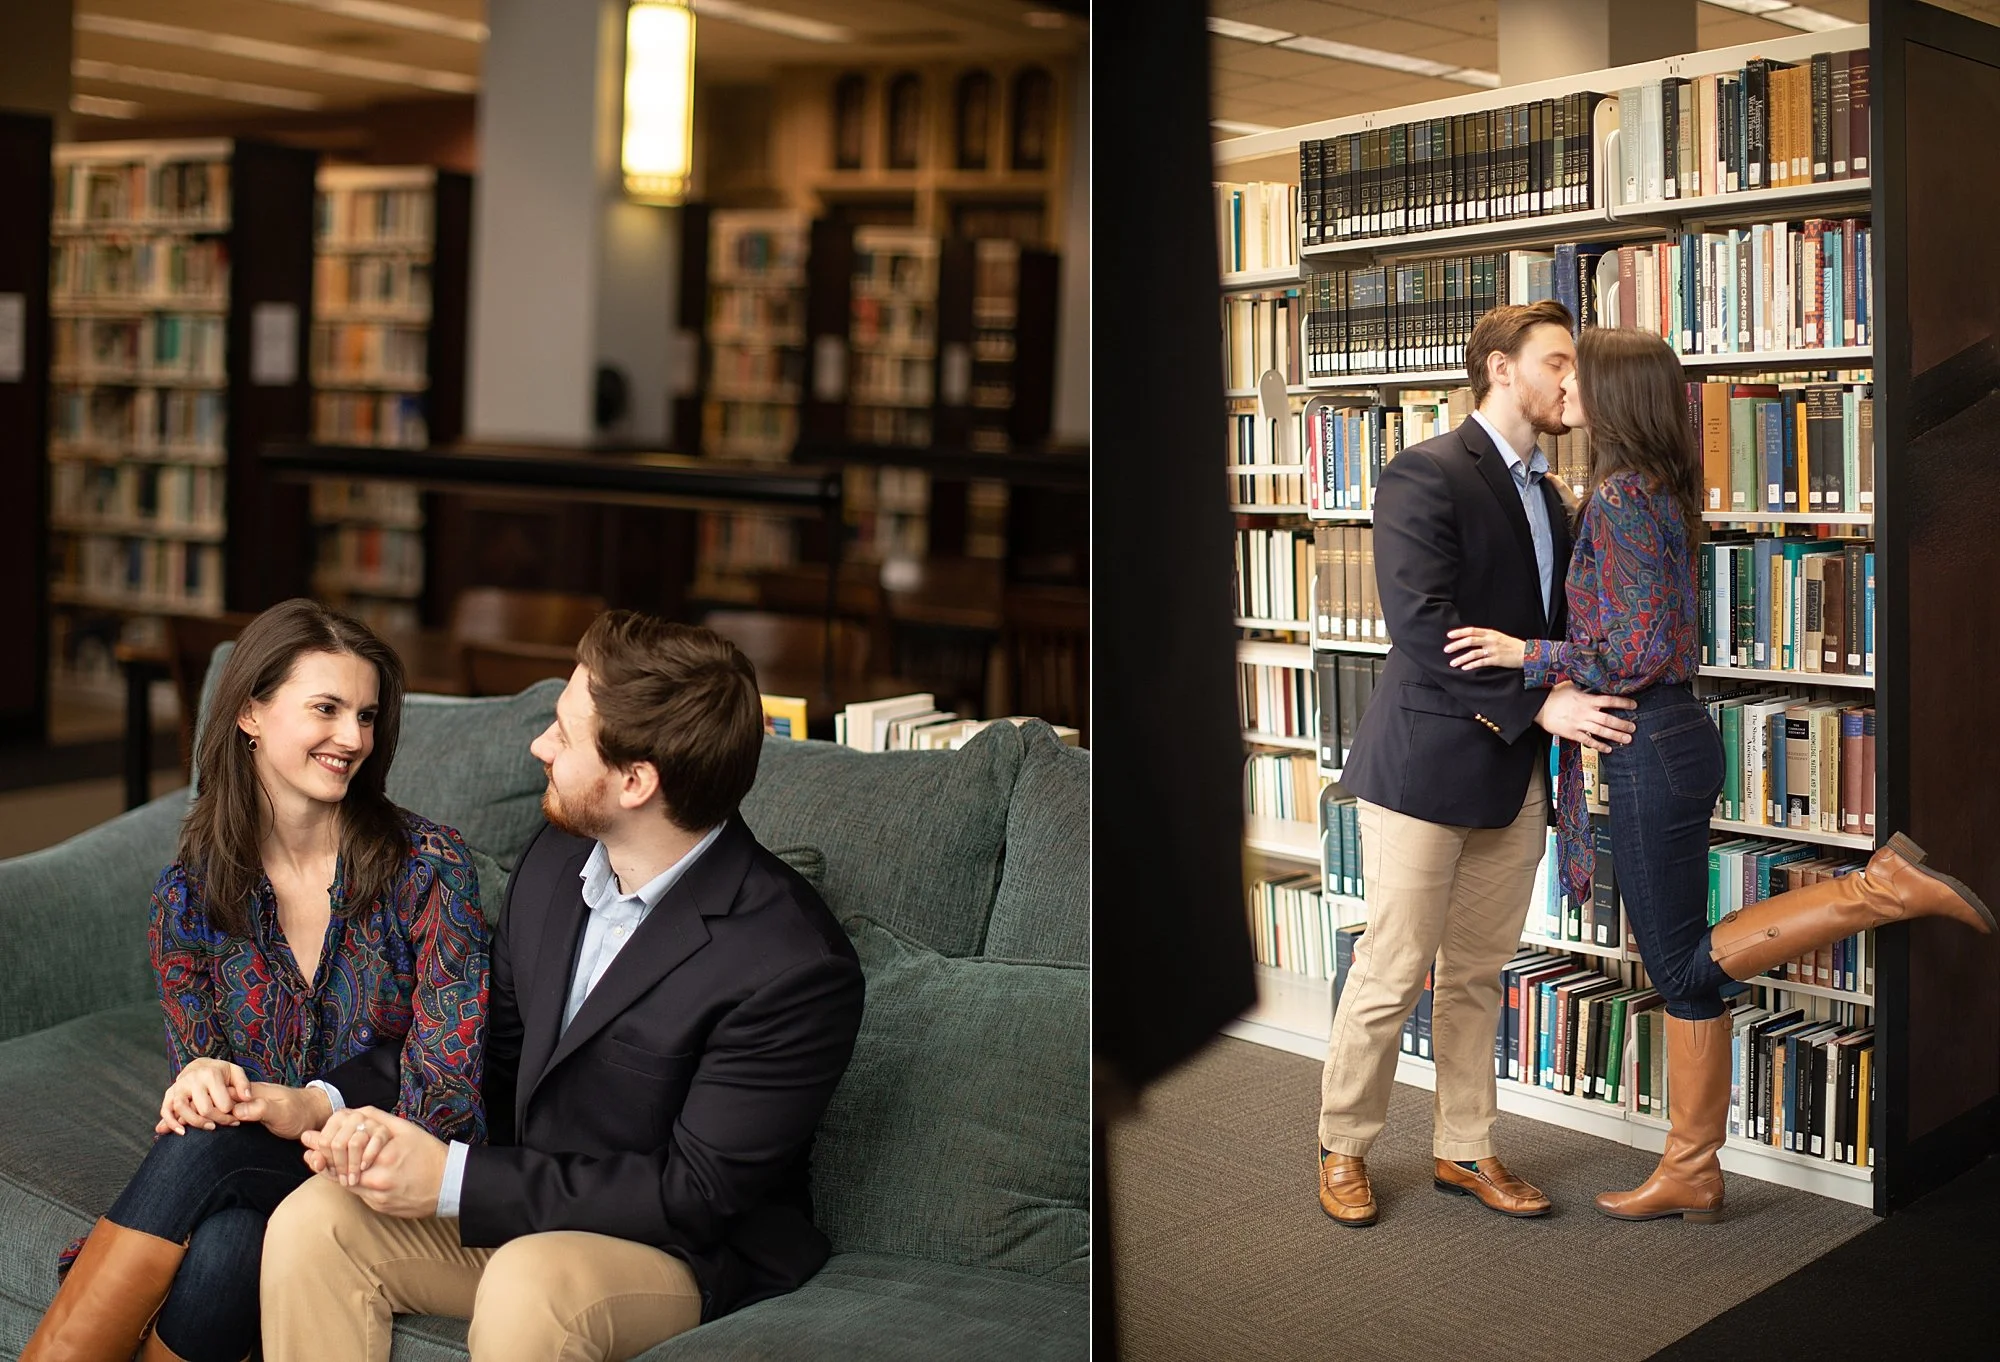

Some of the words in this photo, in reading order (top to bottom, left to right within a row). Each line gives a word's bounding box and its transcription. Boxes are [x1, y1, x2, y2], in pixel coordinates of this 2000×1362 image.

[1748, 95, 1756, 116] World
[1754, 99, 1763, 142] Masterpieces
[1748, 116, 1756, 151] Philosophy
[1326, 422, 1335, 475] DISCONTINUOUS
[1809, 583, 1819, 631] VEDANTA
